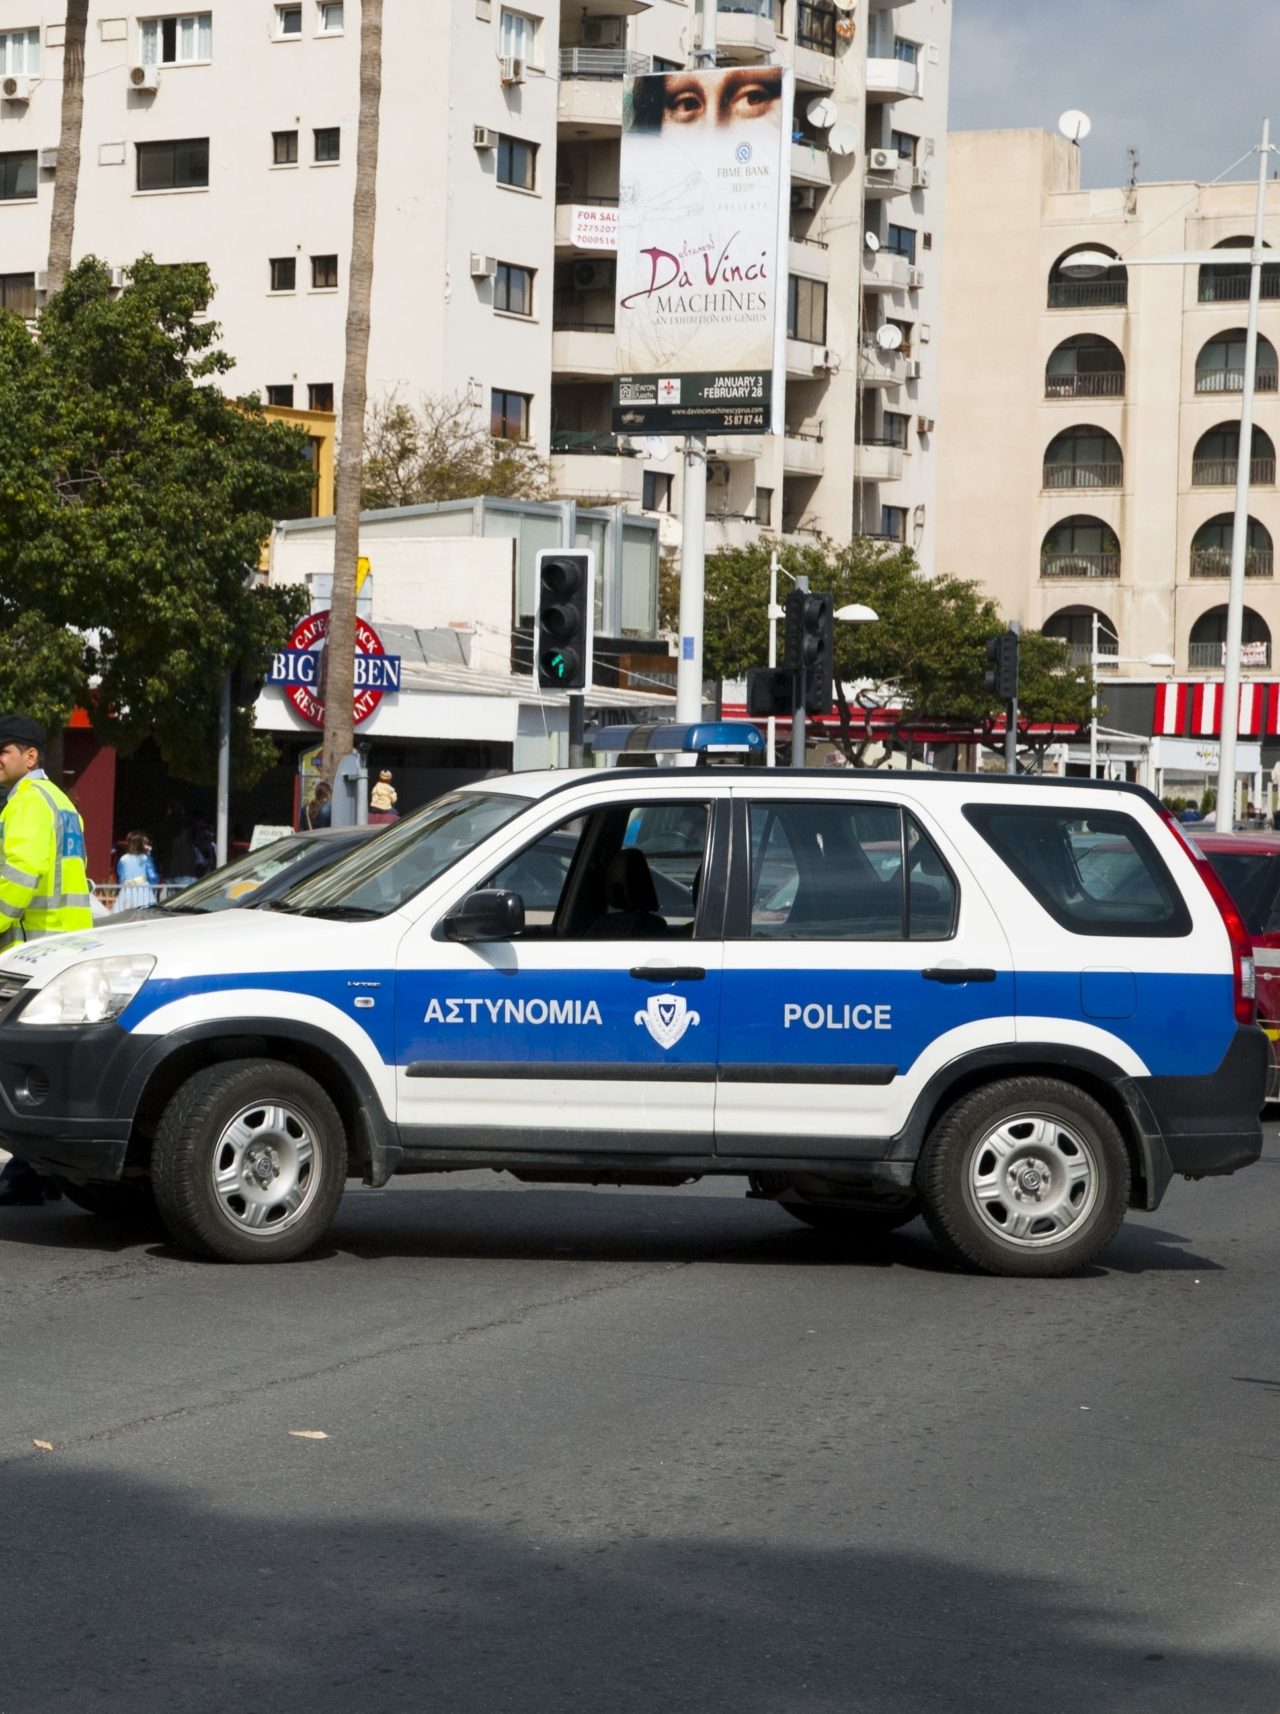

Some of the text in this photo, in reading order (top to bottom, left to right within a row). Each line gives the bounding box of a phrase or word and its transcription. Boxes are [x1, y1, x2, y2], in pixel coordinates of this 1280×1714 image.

[717, 165, 770, 178] FBME BANK
[577, 211, 597, 220] FOR
[577, 224, 617, 233] 2275207
[576, 235, 616, 246] 7000516
[620, 230, 767, 309] Da Vinci
[656, 289, 767, 314] MACHINES
[669, 313, 720, 325] EXHIBITION
[721, 313, 733, 323] OF
[734, 312, 767, 323] GENIUS
[713, 376, 763, 388] JANUARY 3
[703, 387, 750, 399] FEBRUARY
[751, 387, 763, 397] 28
[671, 407, 763, 416] www.davincimachinescyprus.com
[724, 414, 763, 425] 25 87 87 44
[271, 653, 400, 687] BIG BEN
[423, 997, 603, 1026] ΑΣΤΥΝΟΜΙΑ
[783, 1002, 892, 1030] POLICE
